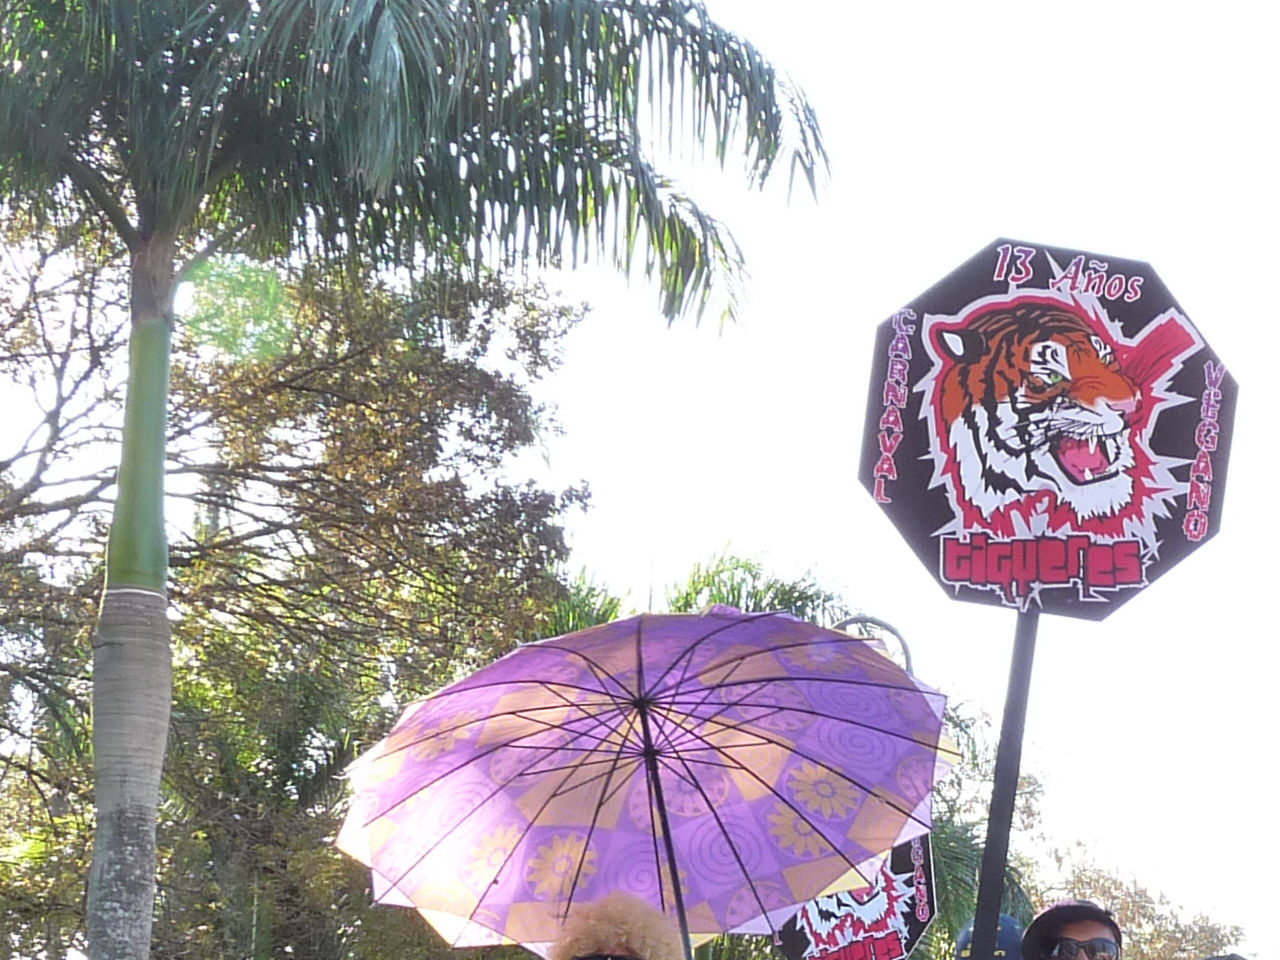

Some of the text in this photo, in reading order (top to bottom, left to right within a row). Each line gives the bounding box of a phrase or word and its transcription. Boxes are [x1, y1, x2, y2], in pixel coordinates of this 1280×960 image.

[993, 244, 1143, 301] 13 Años
[873, 307, 916, 503] CARNAVAL
[1181, 361, 1225, 541] VEGANO
[911, 837, 930, 923] GANO
